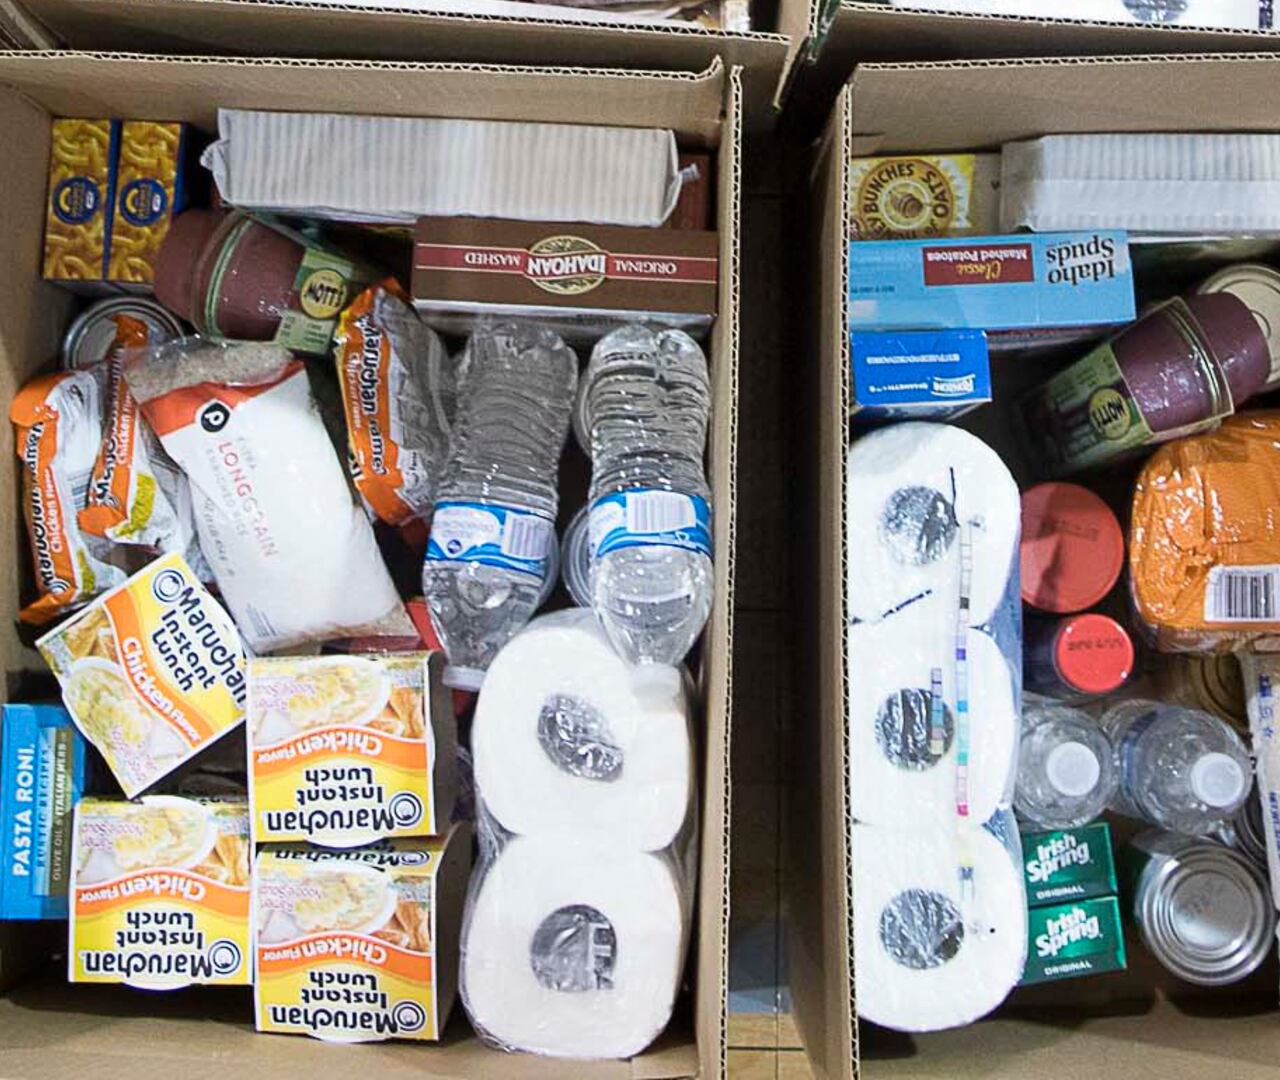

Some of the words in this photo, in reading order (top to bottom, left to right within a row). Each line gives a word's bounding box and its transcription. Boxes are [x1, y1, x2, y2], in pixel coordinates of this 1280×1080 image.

[863, 162, 915, 214] BUNCHES
[921, 171, 950, 218] OATS
[465, 252, 522, 267] MASHED
[926, 248, 980, 263] Potatoes
[980, 247, 1028, 262] Mashed
[1045, 234, 1115, 265] Spuds
[527, 253, 607, 275] IDAHOAN
[613, 258, 677, 275] ORIGINAL
[957, 259, 1003, 282] Classic
[1047, 258, 1116, 287] Idaho
[361, 325, 382, 414] Maruchan
[46, 499, 64, 553] Chicken
[161, 610, 217, 690] Instant
[178, 586, 248, 704] Maruchan
[151, 628, 195, 692] Lunch
[122, 636, 173, 716] Chicken
[171, 710, 201, 742] Flavor
[296, 729, 383, 755] Chicken
[55, 742, 67, 773] HERB
[257, 746, 297, 765] Flavor
[306, 767, 374, 785] Lunch
[54, 773, 66, 817] ITALIAN
[297, 785, 384, 805] Instant
[267, 809, 395, 832] Maruchan
[13, 815, 32, 877] PASTA
[54, 829, 64, 846] OIL
[1036, 833, 1077, 862] Irish
[52, 849, 63, 881] OLIVE
[275, 849, 400, 867] Maruchan
[1025, 841, 1091, 883] Spring
[79, 886, 121, 903] Flavor
[121, 880, 207, 902] Chicken
[1036, 884, 1085, 900] ORIGINAL
[126, 911, 194, 929] Lunch
[1046, 905, 1088, 937] Irish
[116, 930, 203, 949] Instant
[1034, 915, 1101, 958] Spring
[85, 951, 213, 978] Maruchan
[263, 947, 302, 961] Flavor
[300, 945, 388, 966] Chicken
[1043, 960, 1093, 976] ORIGINAL
[310, 971, 377, 989] Lunch
[300, 988, 388, 1009] Instant
[271, 1007, 399, 1036] Maruchan
